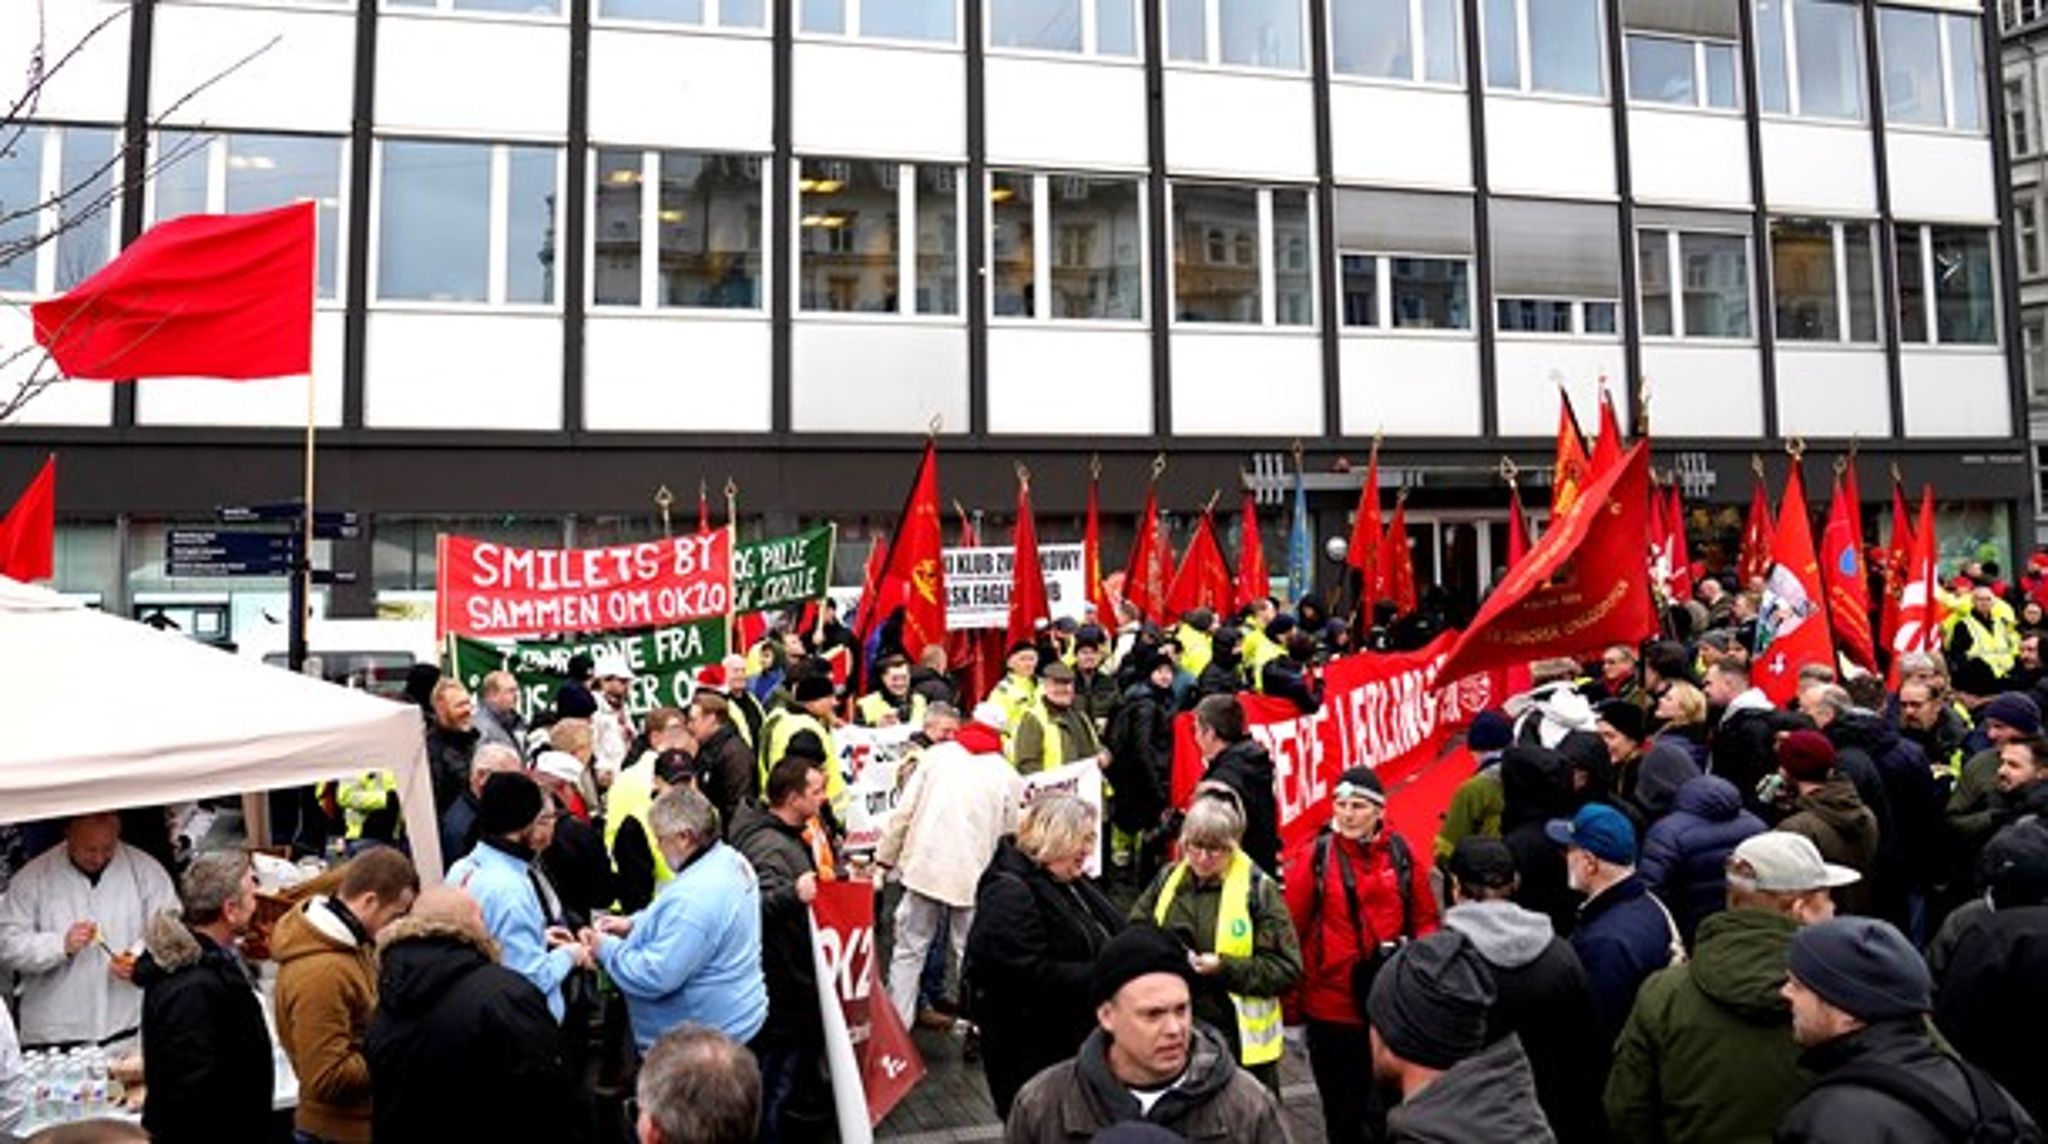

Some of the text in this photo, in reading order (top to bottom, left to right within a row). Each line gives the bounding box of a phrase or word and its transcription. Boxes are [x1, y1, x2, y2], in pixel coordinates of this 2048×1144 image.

[471, 535, 717, 591] SMILETS BY
[469, 594, 600, 631] SAMMEN
[609, 593, 652, 624] OM
[655, 624, 702, 665] FRA
